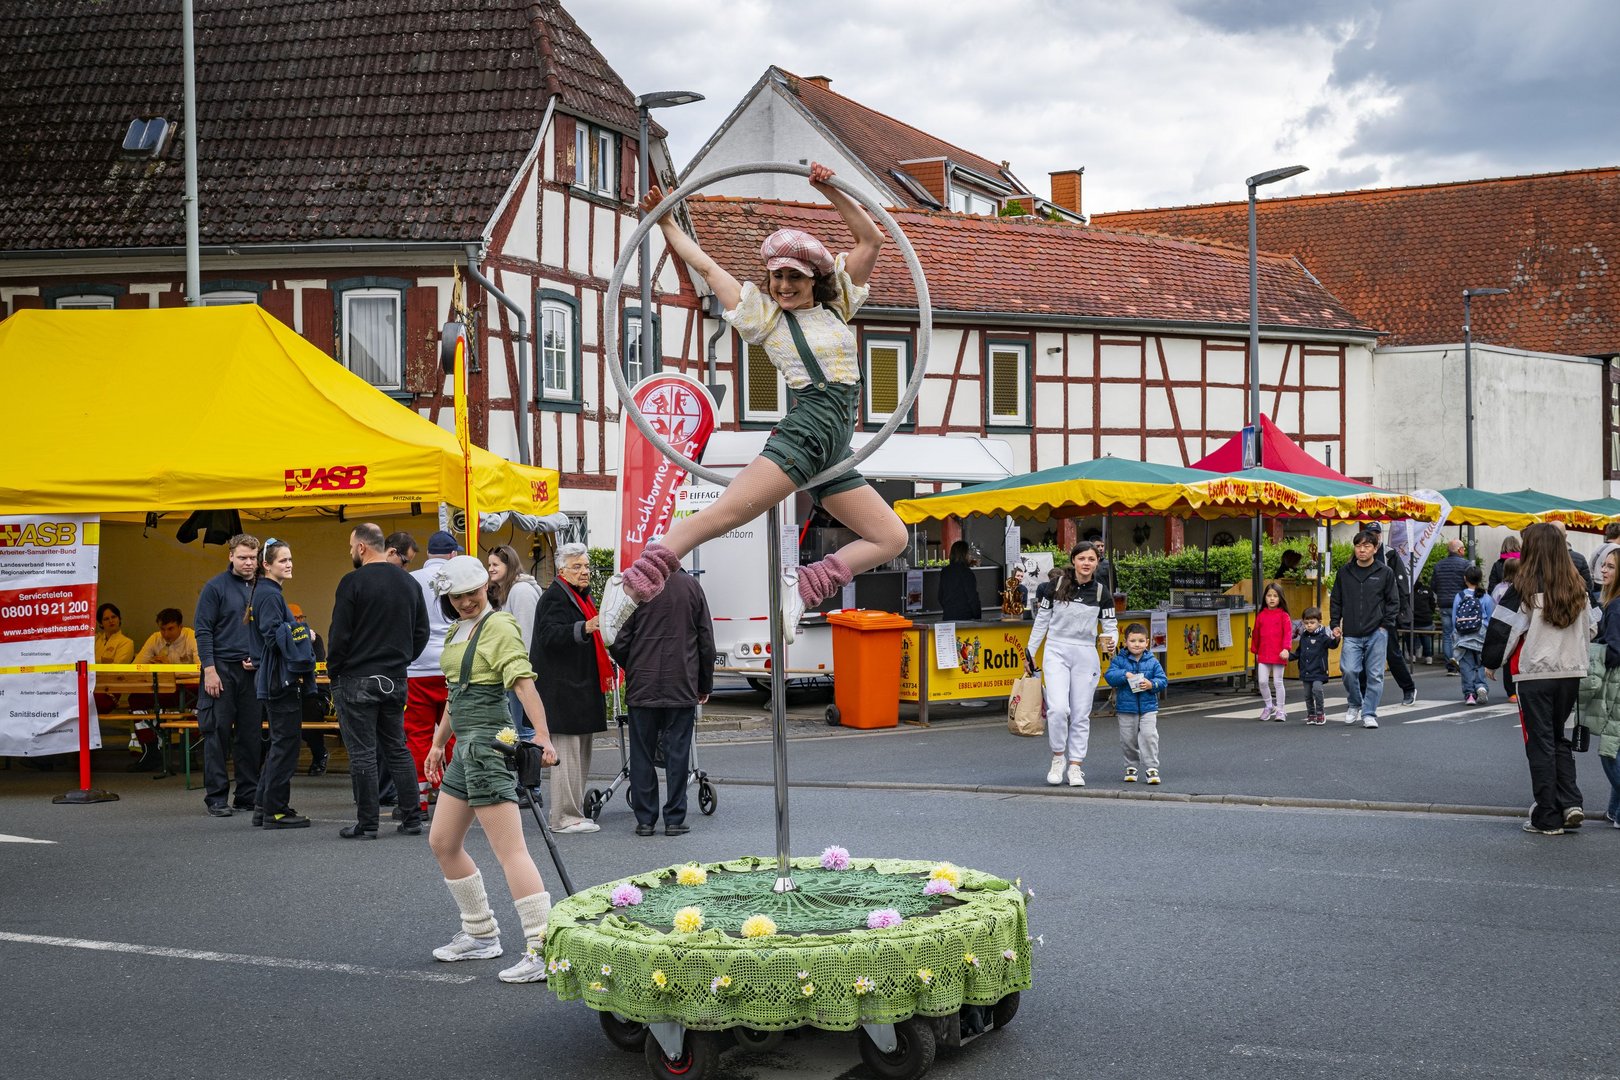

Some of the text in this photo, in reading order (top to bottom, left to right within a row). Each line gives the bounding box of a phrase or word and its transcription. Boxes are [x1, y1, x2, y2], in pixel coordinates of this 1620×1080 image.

[305, 465, 367, 491] ASB
[689, 491, 720, 500] EIFFAGE
[16, 522, 77, 547] ASB
[720, 529, 754, 539] schborn
[19, 591, 73, 600] Servicetelefon
[1, 600, 89, 618] 0800 19 21 200
[3, 624, 90, 636] www.asb-westhessen.de
[983, 647, 1018, 670] Roth
[959, 681, 983, 690] EBBELWOI
[984, 680, 993, 688] AUS
[9, 710, 60, 718] Sanitätsdienst
